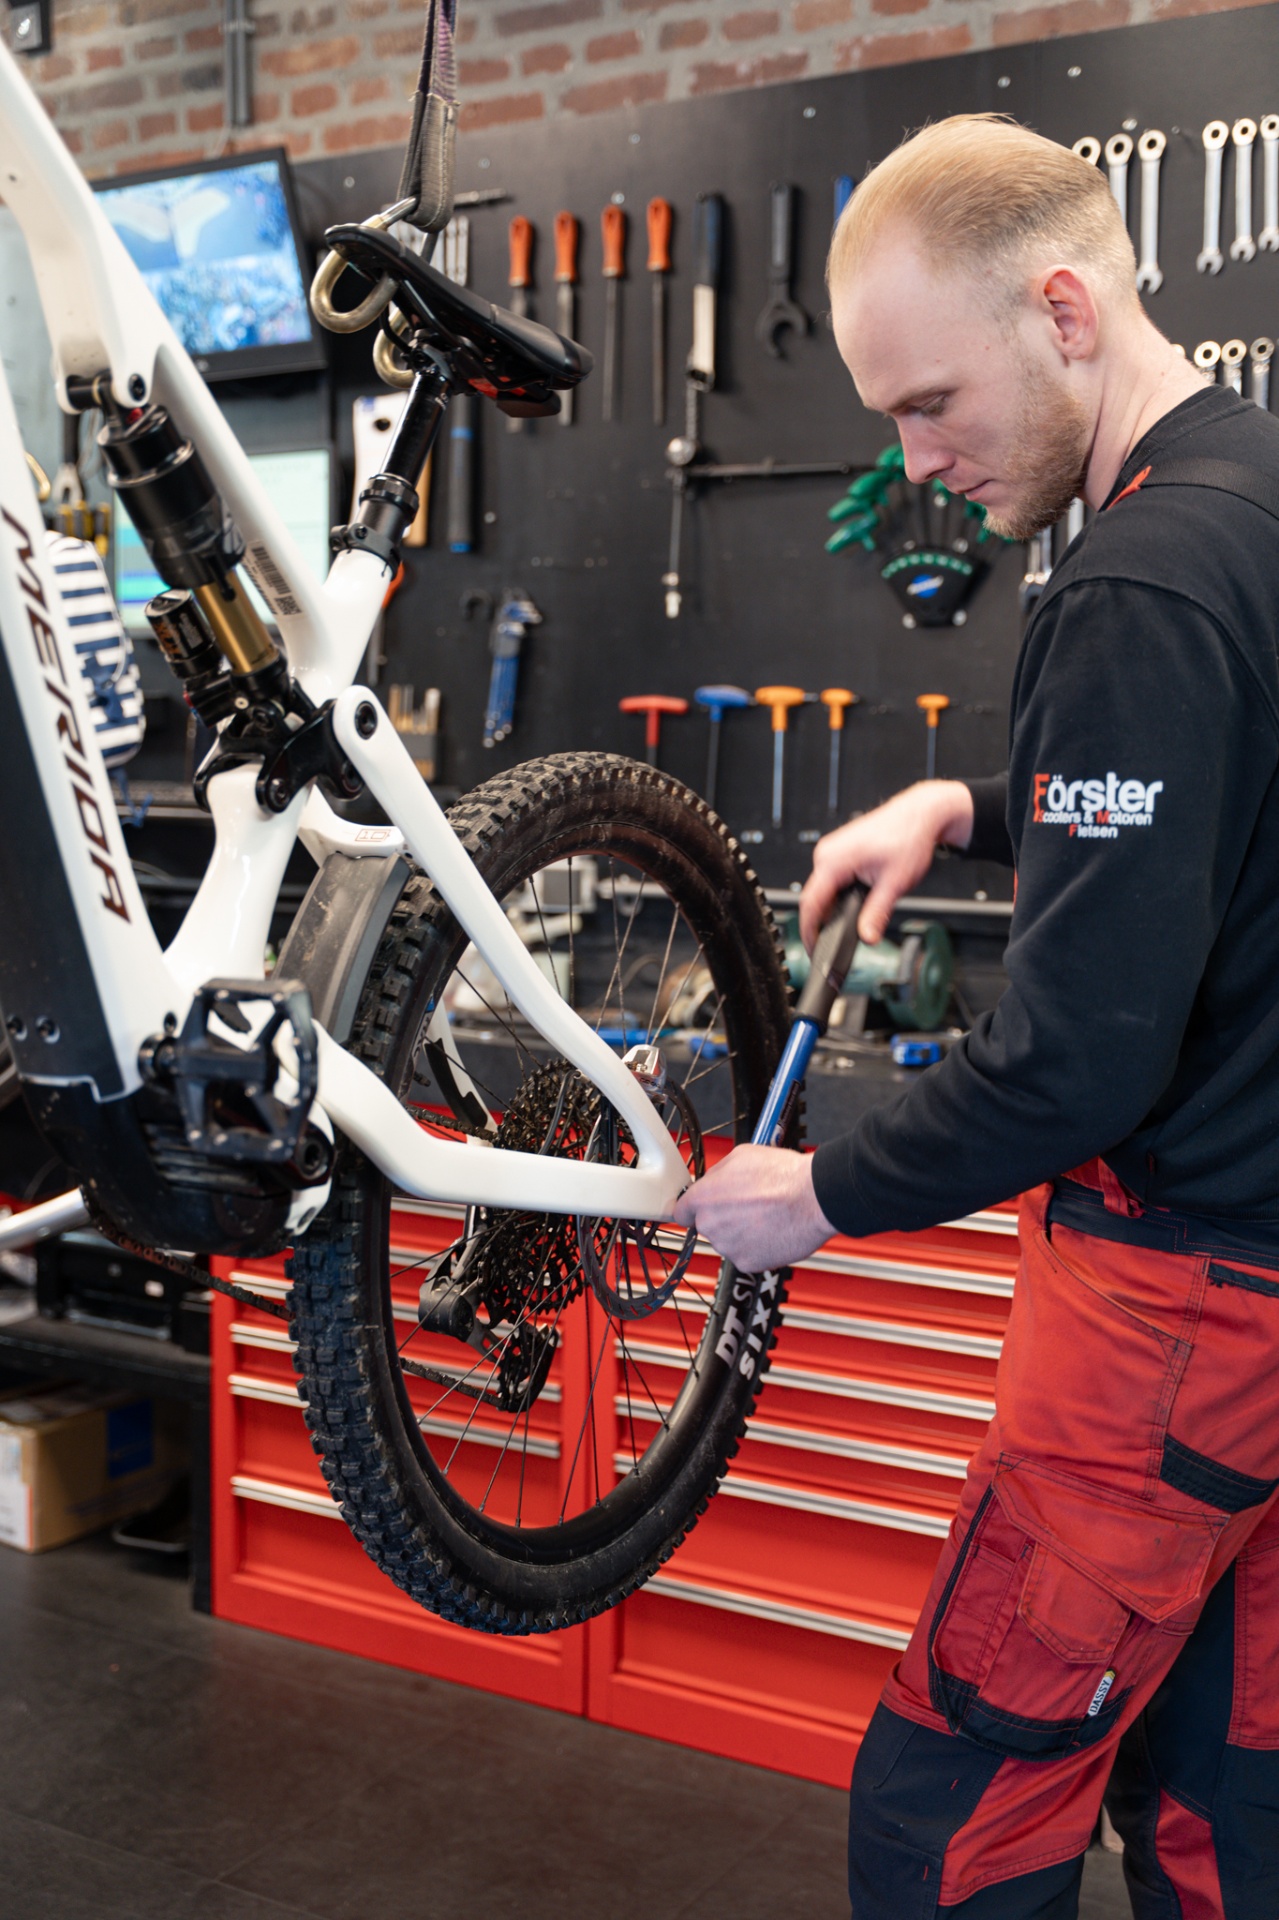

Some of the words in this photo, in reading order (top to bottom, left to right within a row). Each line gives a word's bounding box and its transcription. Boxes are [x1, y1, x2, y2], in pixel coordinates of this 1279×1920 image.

[1, 505, 131, 923] MERIDA
[1034, 771, 1163, 815] Förster
[1069, 824, 1118, 838] Fietsen
[1096, 810, 1152, 825] Motoren
[715, 1305, 745, 1368] DT
[1089, 1680, 1110, 1713] DASSY
